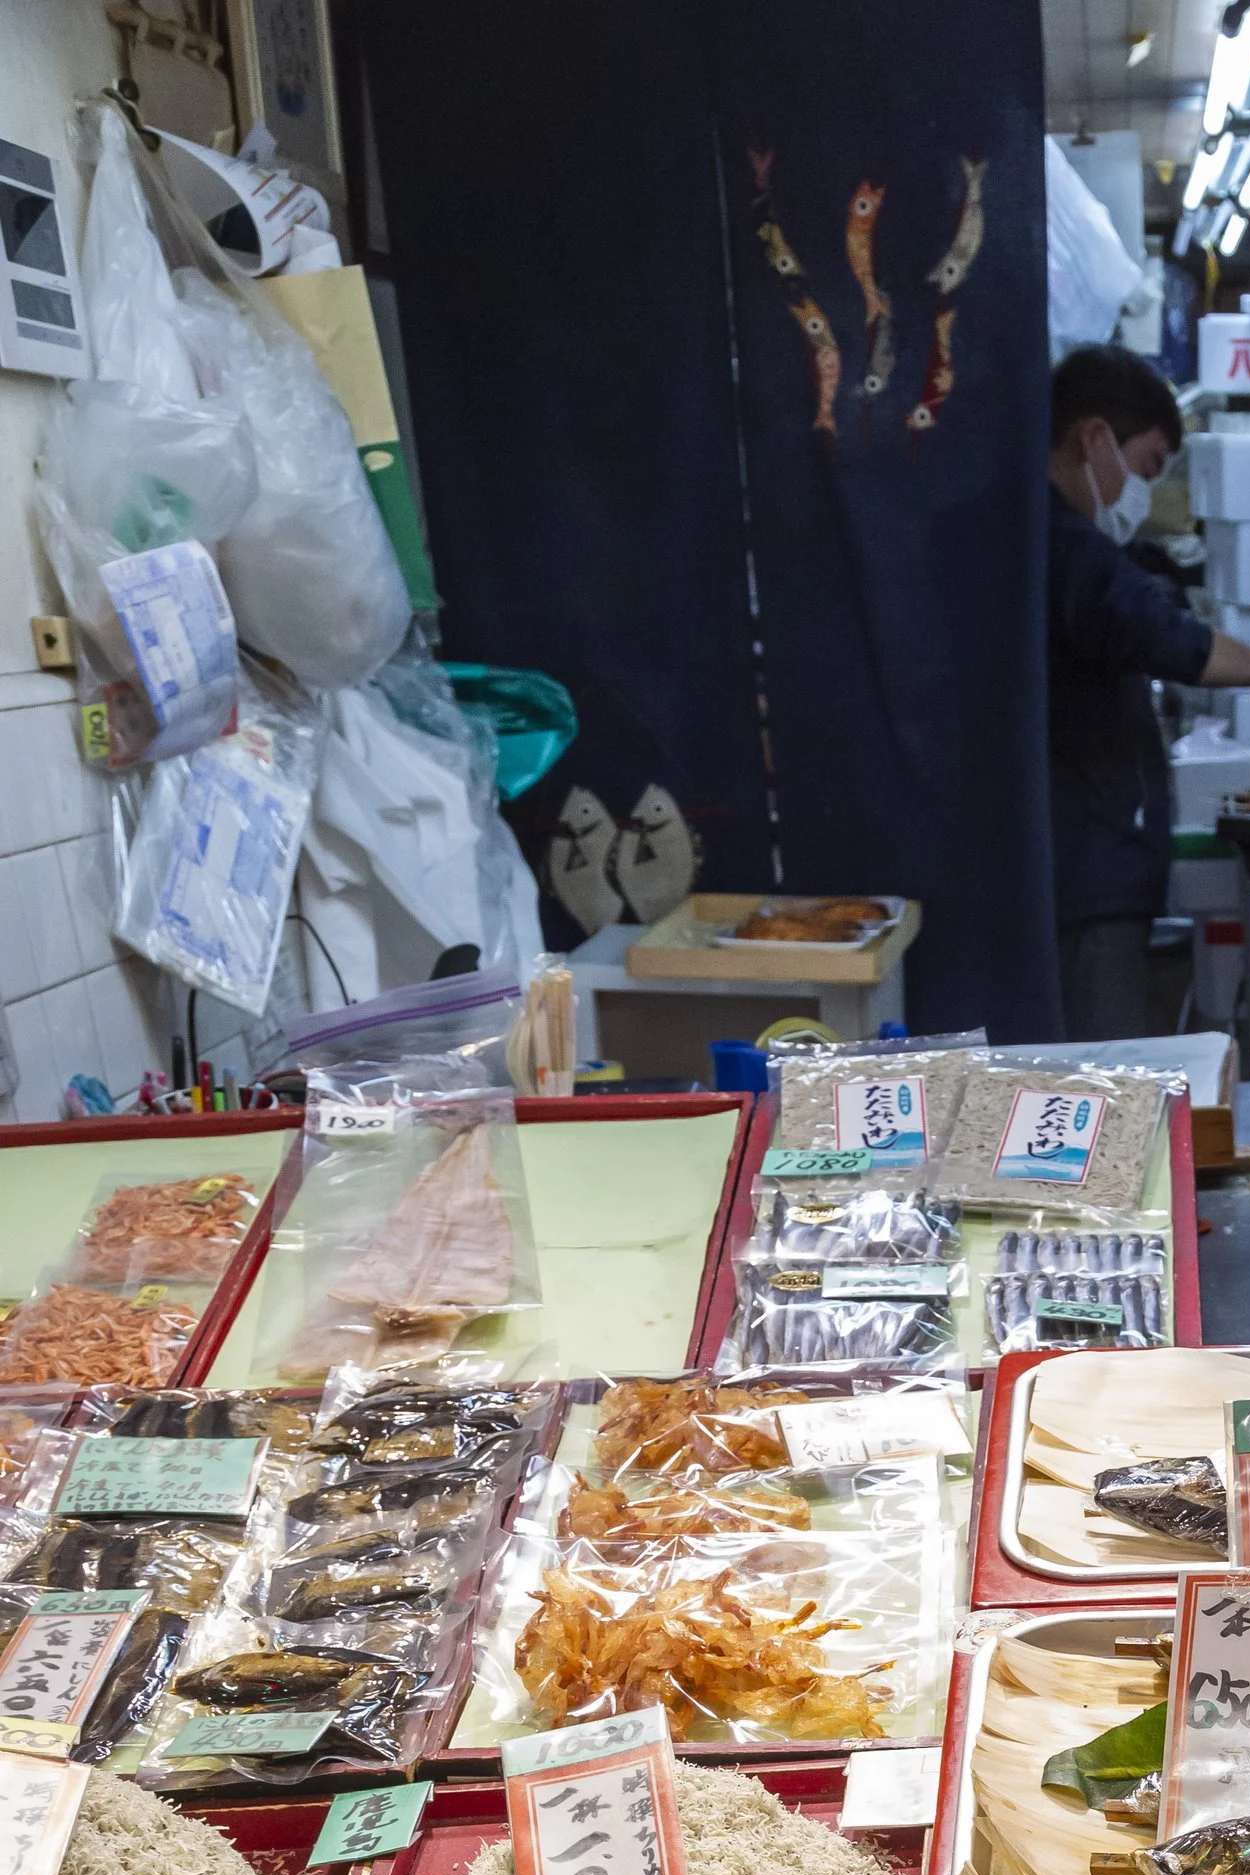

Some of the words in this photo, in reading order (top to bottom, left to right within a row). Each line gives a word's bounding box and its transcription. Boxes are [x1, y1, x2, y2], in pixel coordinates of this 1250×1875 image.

[1027, 1096, 1074, 1160] たたみいわし
[774, 1158, 859, 1170] 1080
[338, 1791, 400, 1856] 鹿児島
